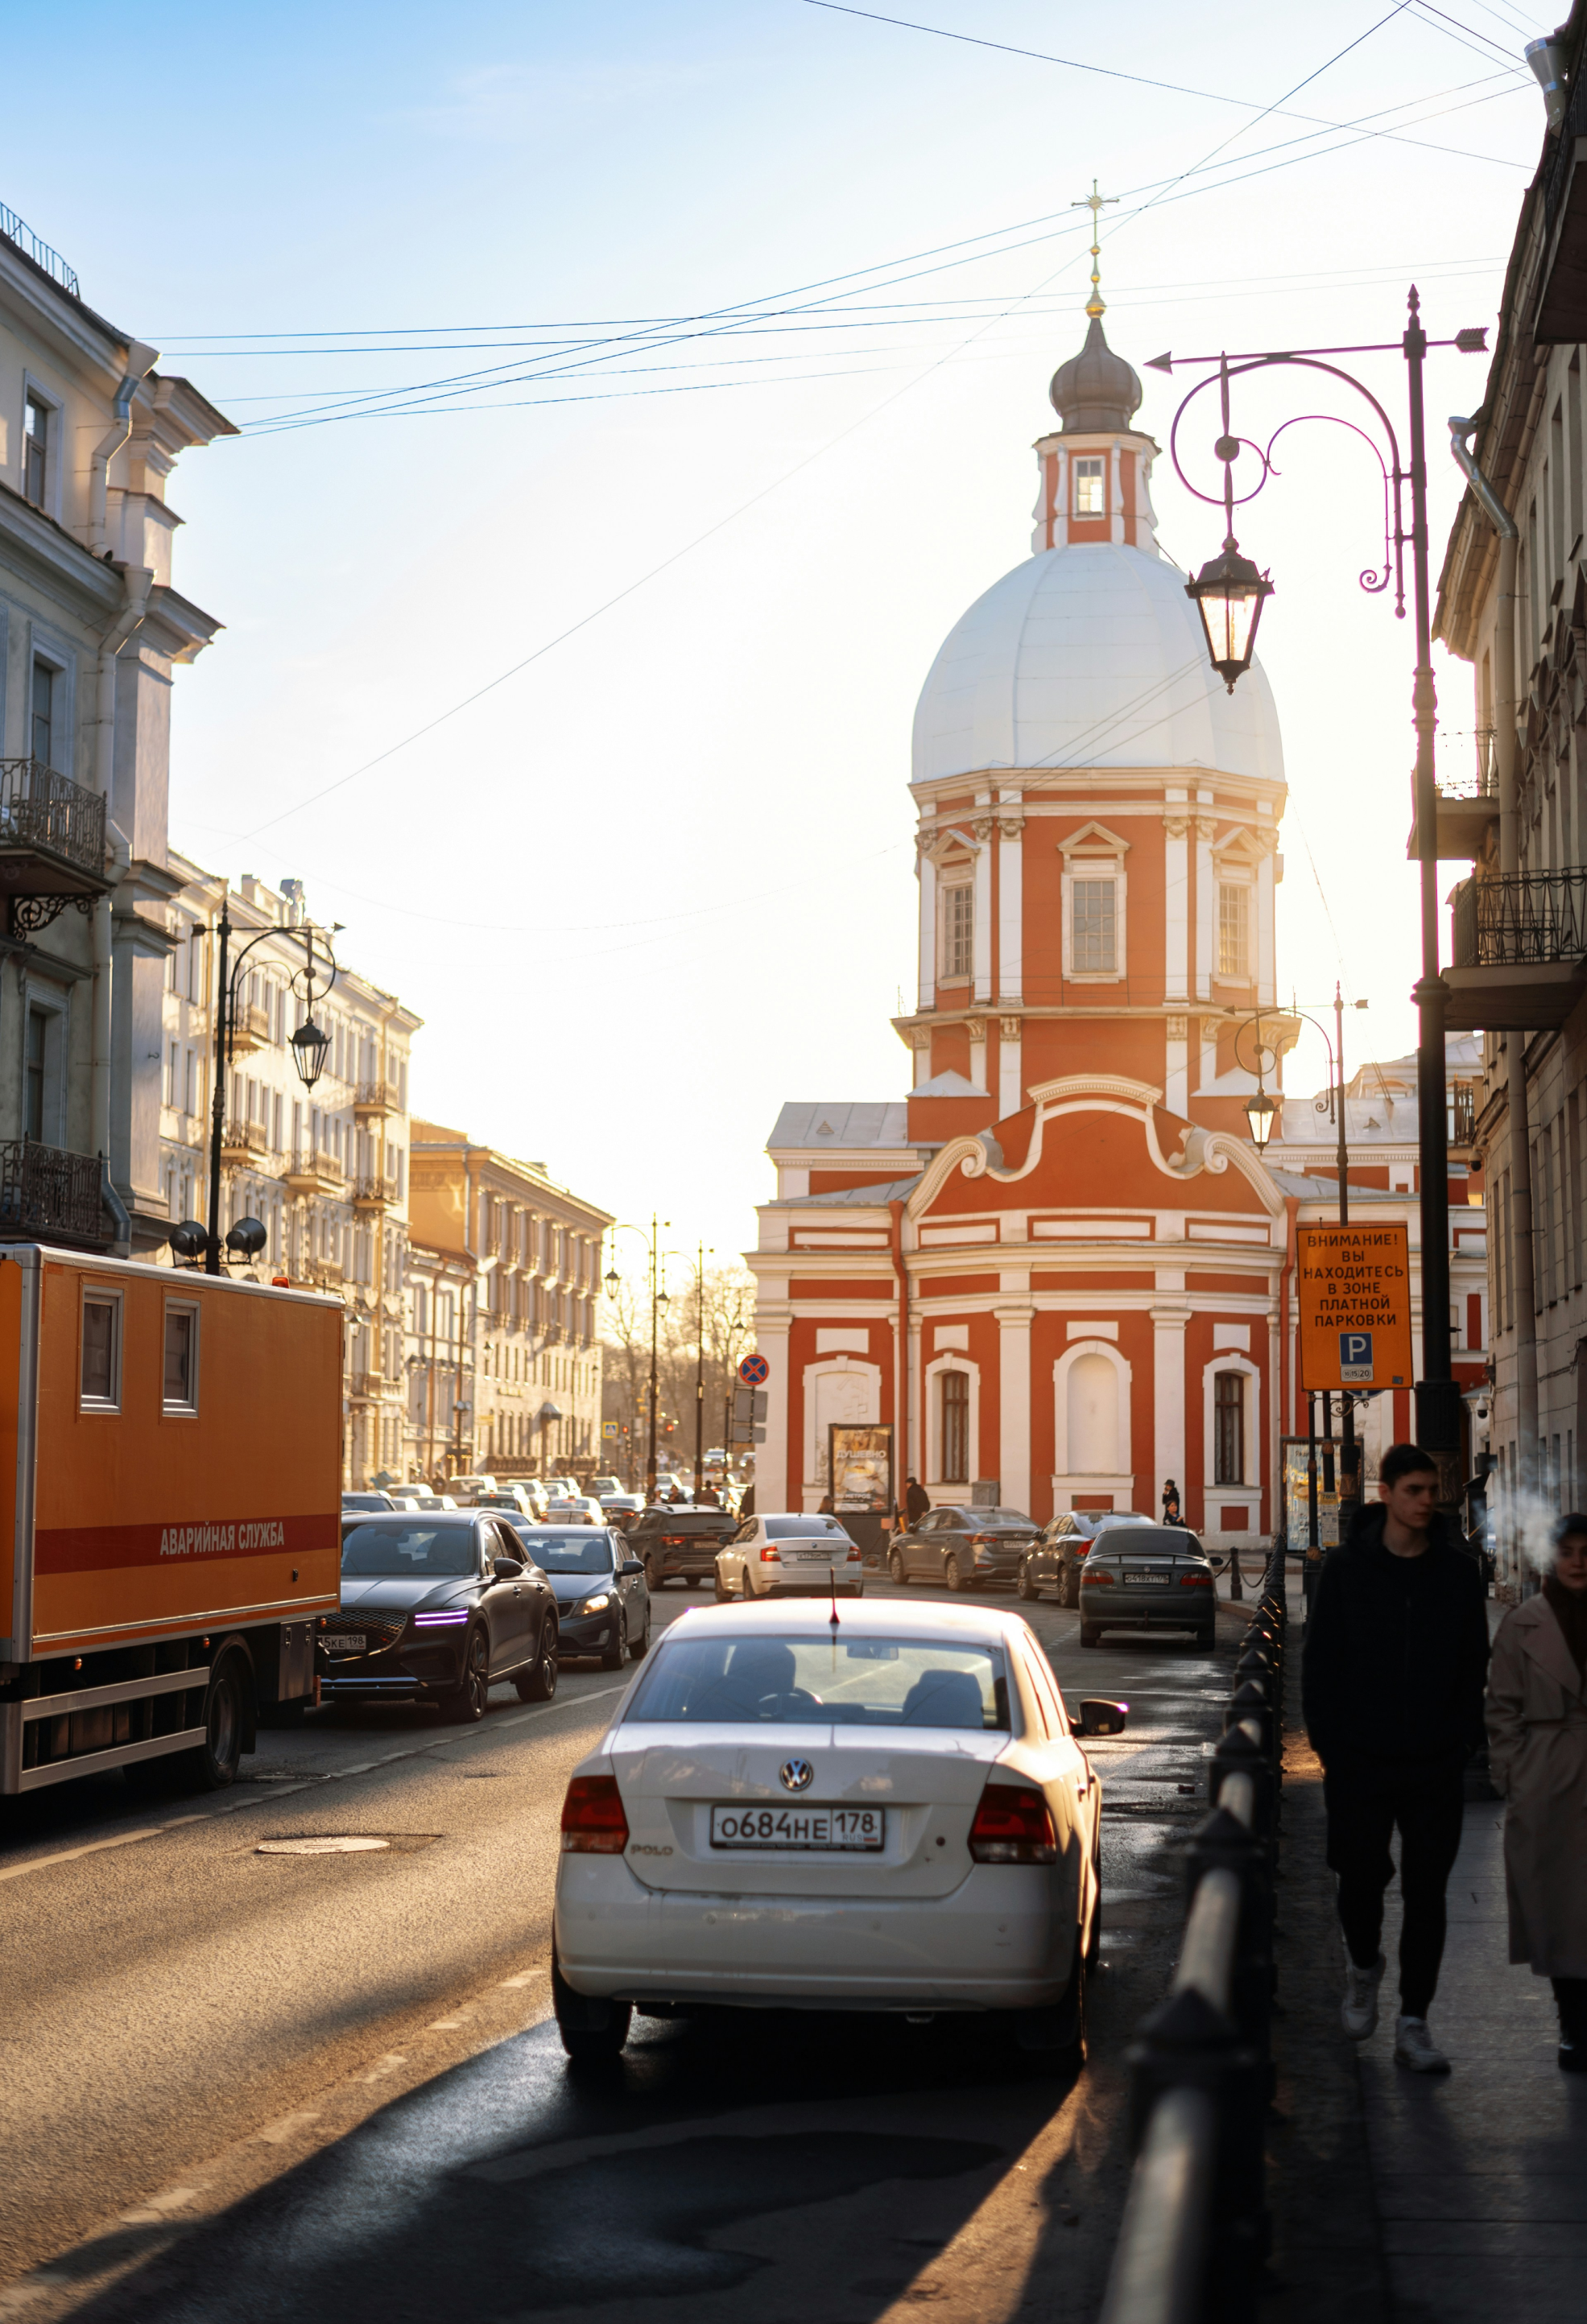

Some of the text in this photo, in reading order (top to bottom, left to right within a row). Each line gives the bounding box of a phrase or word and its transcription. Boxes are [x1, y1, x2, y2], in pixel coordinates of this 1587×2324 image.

[1308, 1234, 1398, 1247] ВНИМАНИЕ!
[1341, 1251, 1364, 1262] ВЫ
[1304, 1265, 1403, 1280] НАХОДИТЕСЬ
[1328, 1282, 1381, 1294] В ЗОНЕ
[1320, 1294, 1390, 1311] ПЛАТНОЙ
[1315, 1314, 1396, 1327] ПАРКОВКИ
[1349, 1336, 1366, 1361] P
[1359, 1369, 1370, 1377] 20
[159, 1521, 285, 1555] АВАРИЙНАЯ СЛУЖБА
[347, 1637, 363, 1645] 198
[834, 1813, 874, 1834] 178
[630, 1843, 673, 1856] POLO
